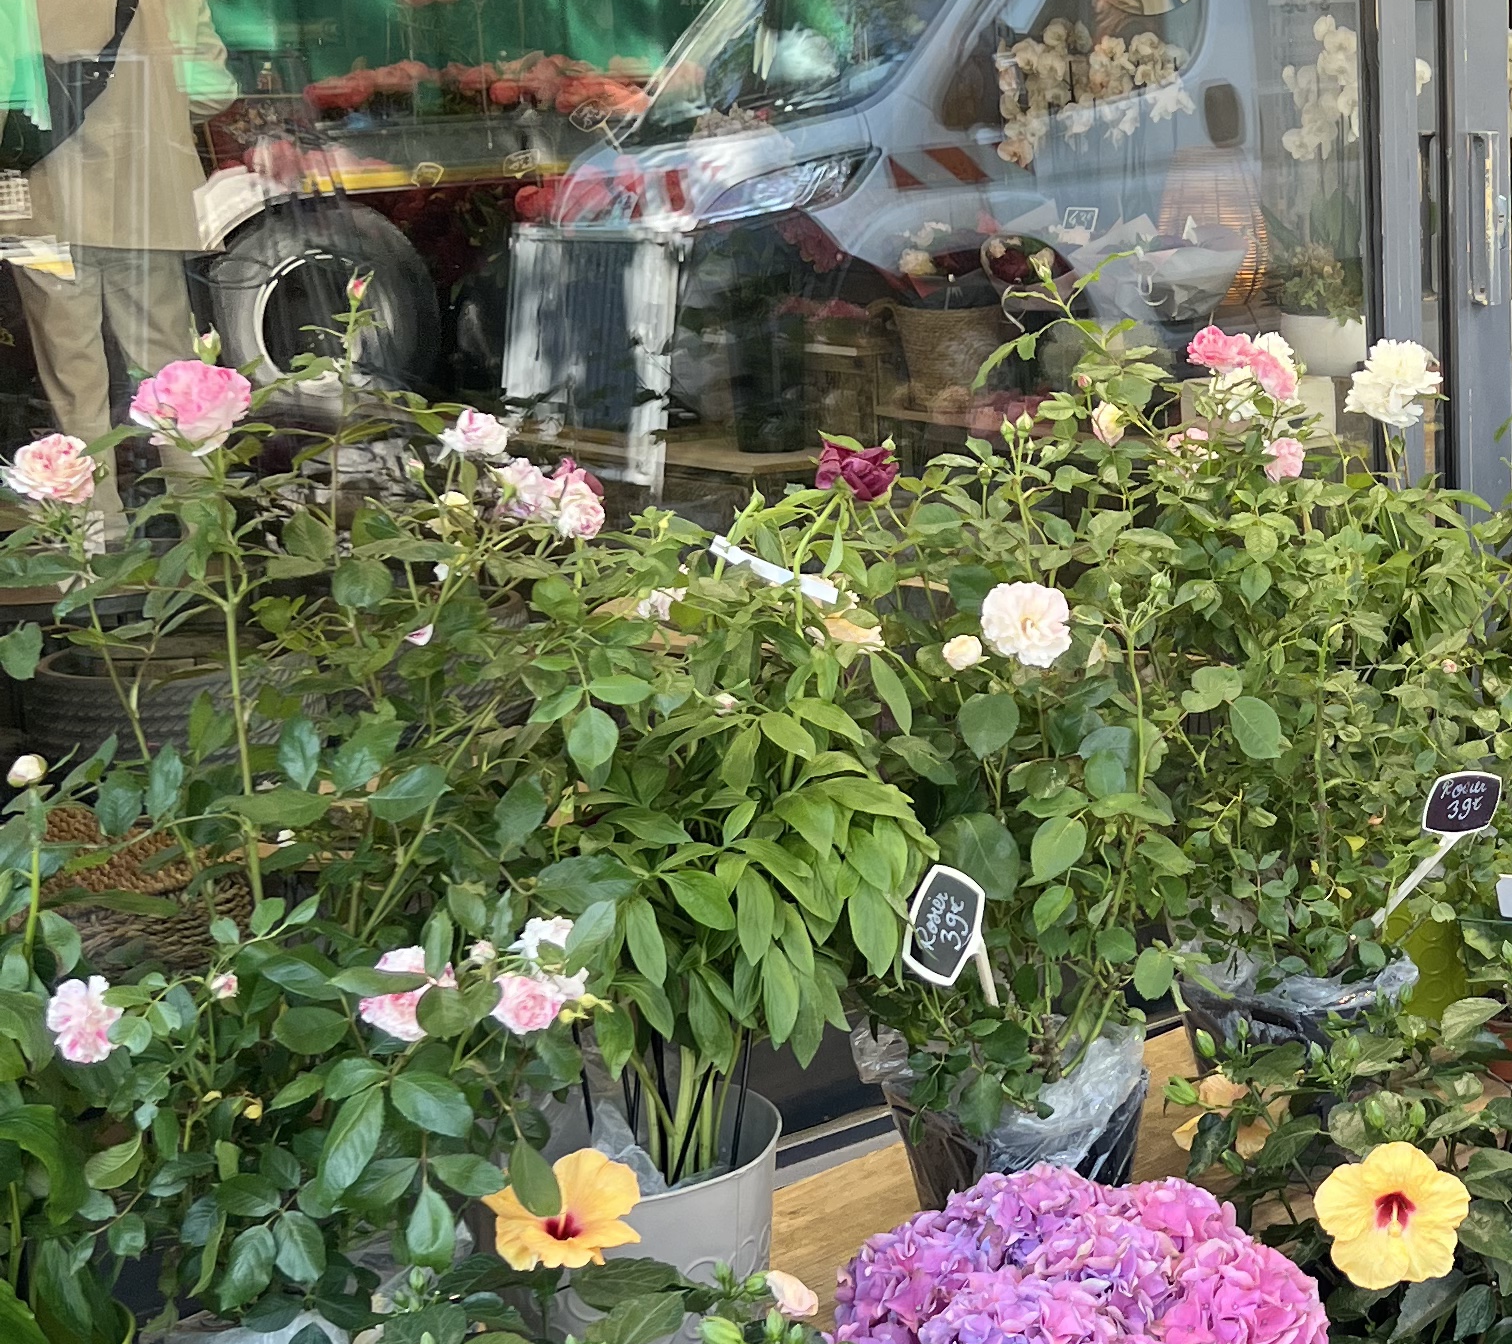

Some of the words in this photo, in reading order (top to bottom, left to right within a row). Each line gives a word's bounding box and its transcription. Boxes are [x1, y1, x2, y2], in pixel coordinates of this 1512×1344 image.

[1441, 778, 1488, 800] Rosier
[916, 892, 949, 951] Rosier
[939, 896, 969, 952] 39€
